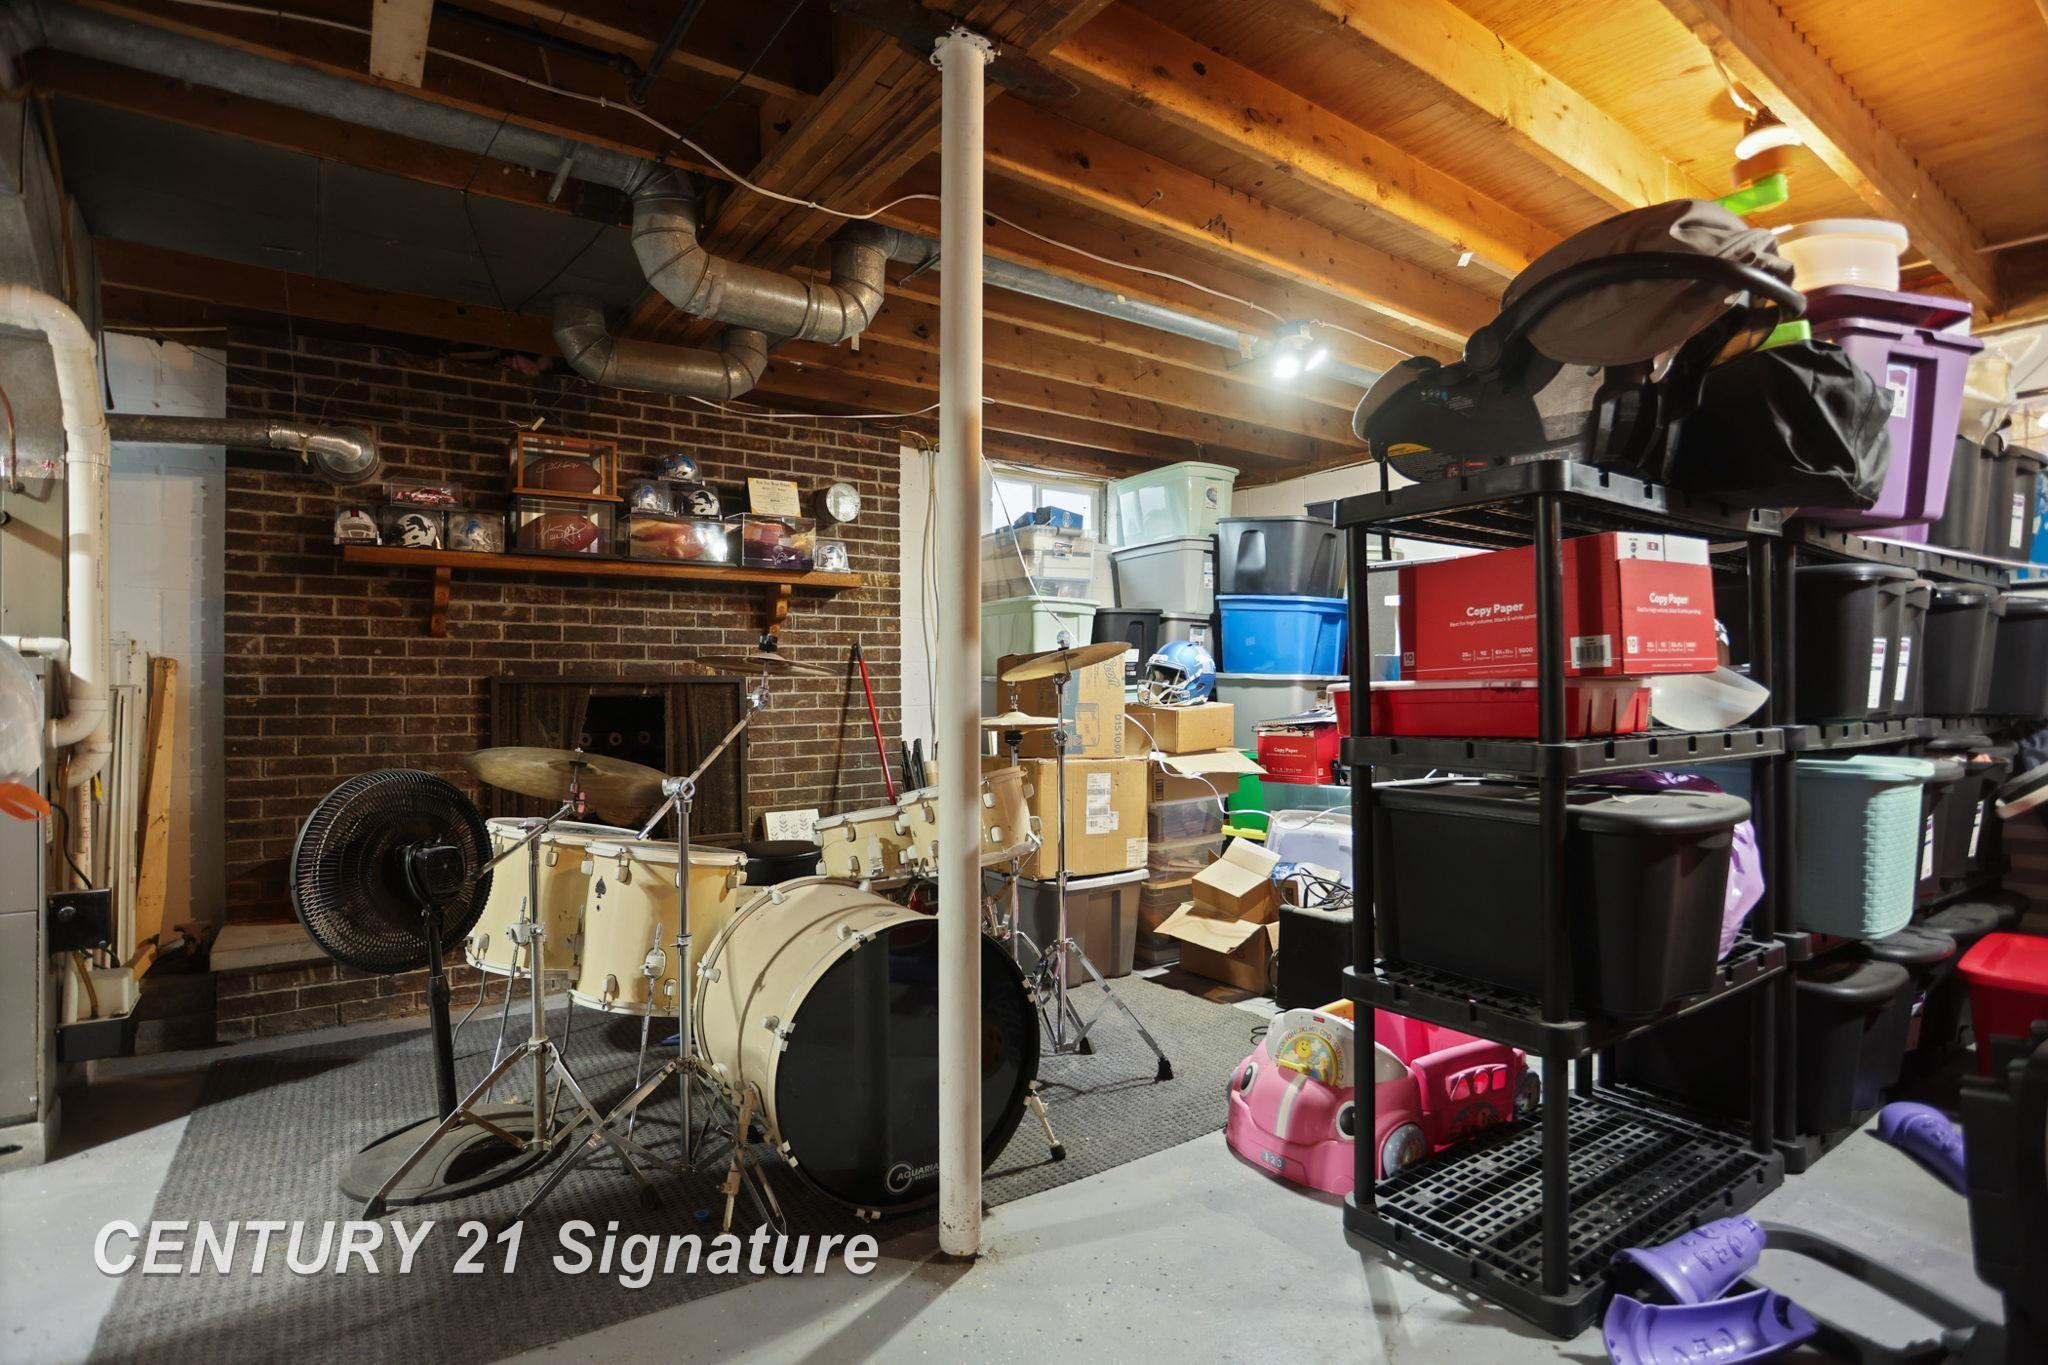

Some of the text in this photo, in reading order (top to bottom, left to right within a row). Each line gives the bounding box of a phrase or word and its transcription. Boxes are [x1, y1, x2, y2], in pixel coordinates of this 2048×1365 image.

[1649, 592, 1688, 606] Copy Paper
[1466, 603, 1524, 617] Copy Paper
[1405, 653, 1413, 662] 10
[896, 1162, 939, 1181] AQUARIA
